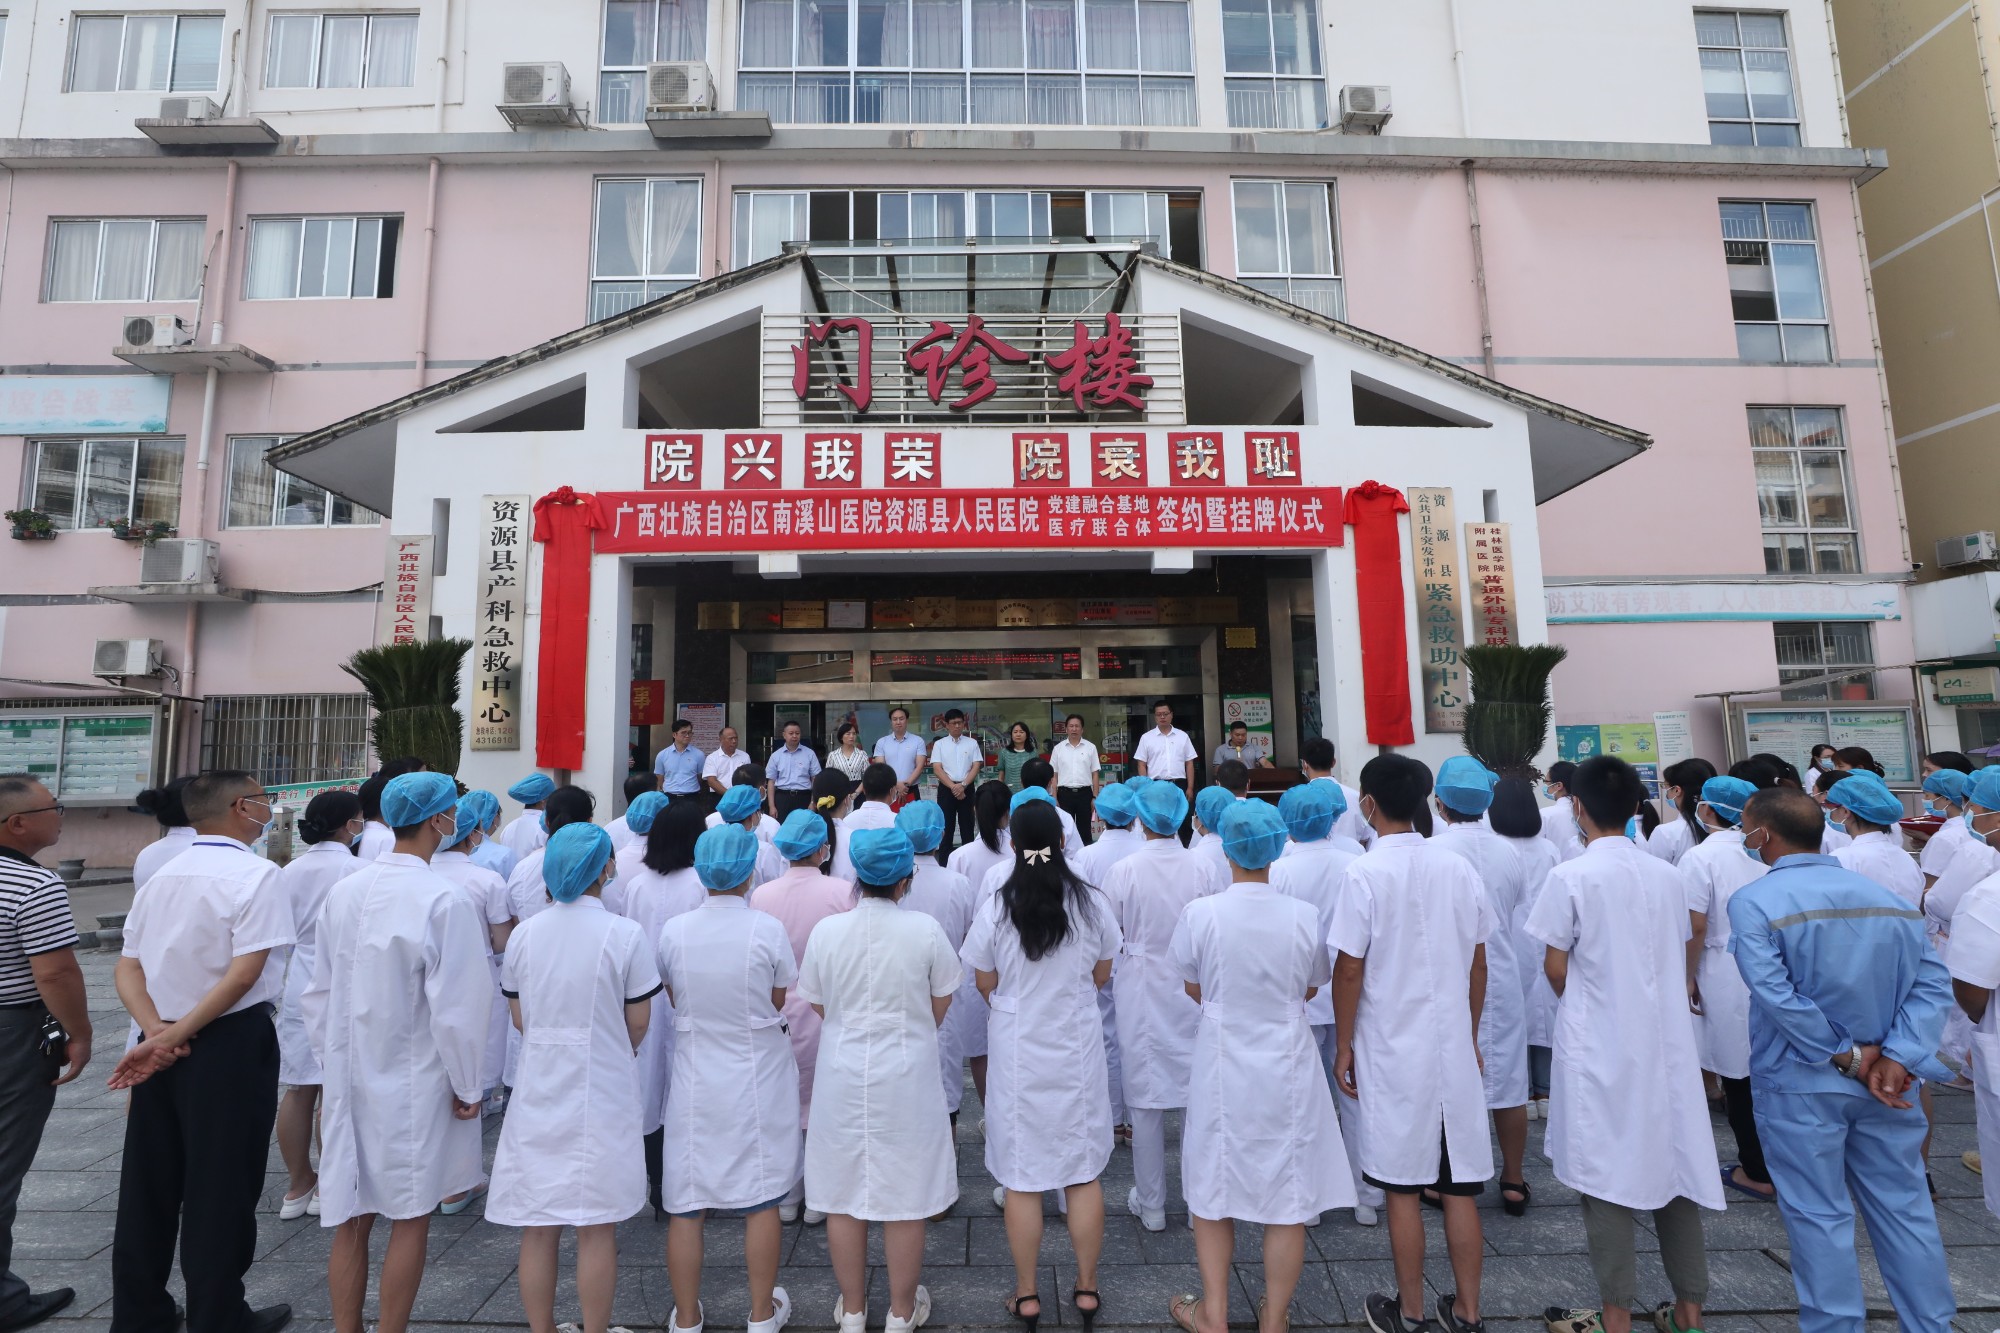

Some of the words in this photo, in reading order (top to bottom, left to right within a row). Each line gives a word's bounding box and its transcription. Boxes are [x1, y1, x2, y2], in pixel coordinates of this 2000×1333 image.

[791, 313, 1154, 413] 门诊楼
[649, 438, 936, 483] 院兴我荣
[1018, 436, 1297, 481] 院衰我耻
[612, 496, 1040, 537] 广西壮族自治区南溪山医院资源县人民医院
[1047, 494, 1150, 515] 党建融合基地
[1048, 517, 1151, 537] 医疗联合体
[1156, 496, 1325, 534] 签约暨挂牌仪式
[1417, 493, 1436, 578] 公共卫生突发事件
[1433, 494, 1452, 577] 资源县
[1474, 527, 1490, 572] 附属医院
[1490, 527, 1505, 572] 桂林医学院
[394, 542, 420, 646] 广西壮族自治区人民医
[480, 500, 521, 724] 资源县产科急救中心
[1425, 583, 1461, 708] 紧急救助中心
